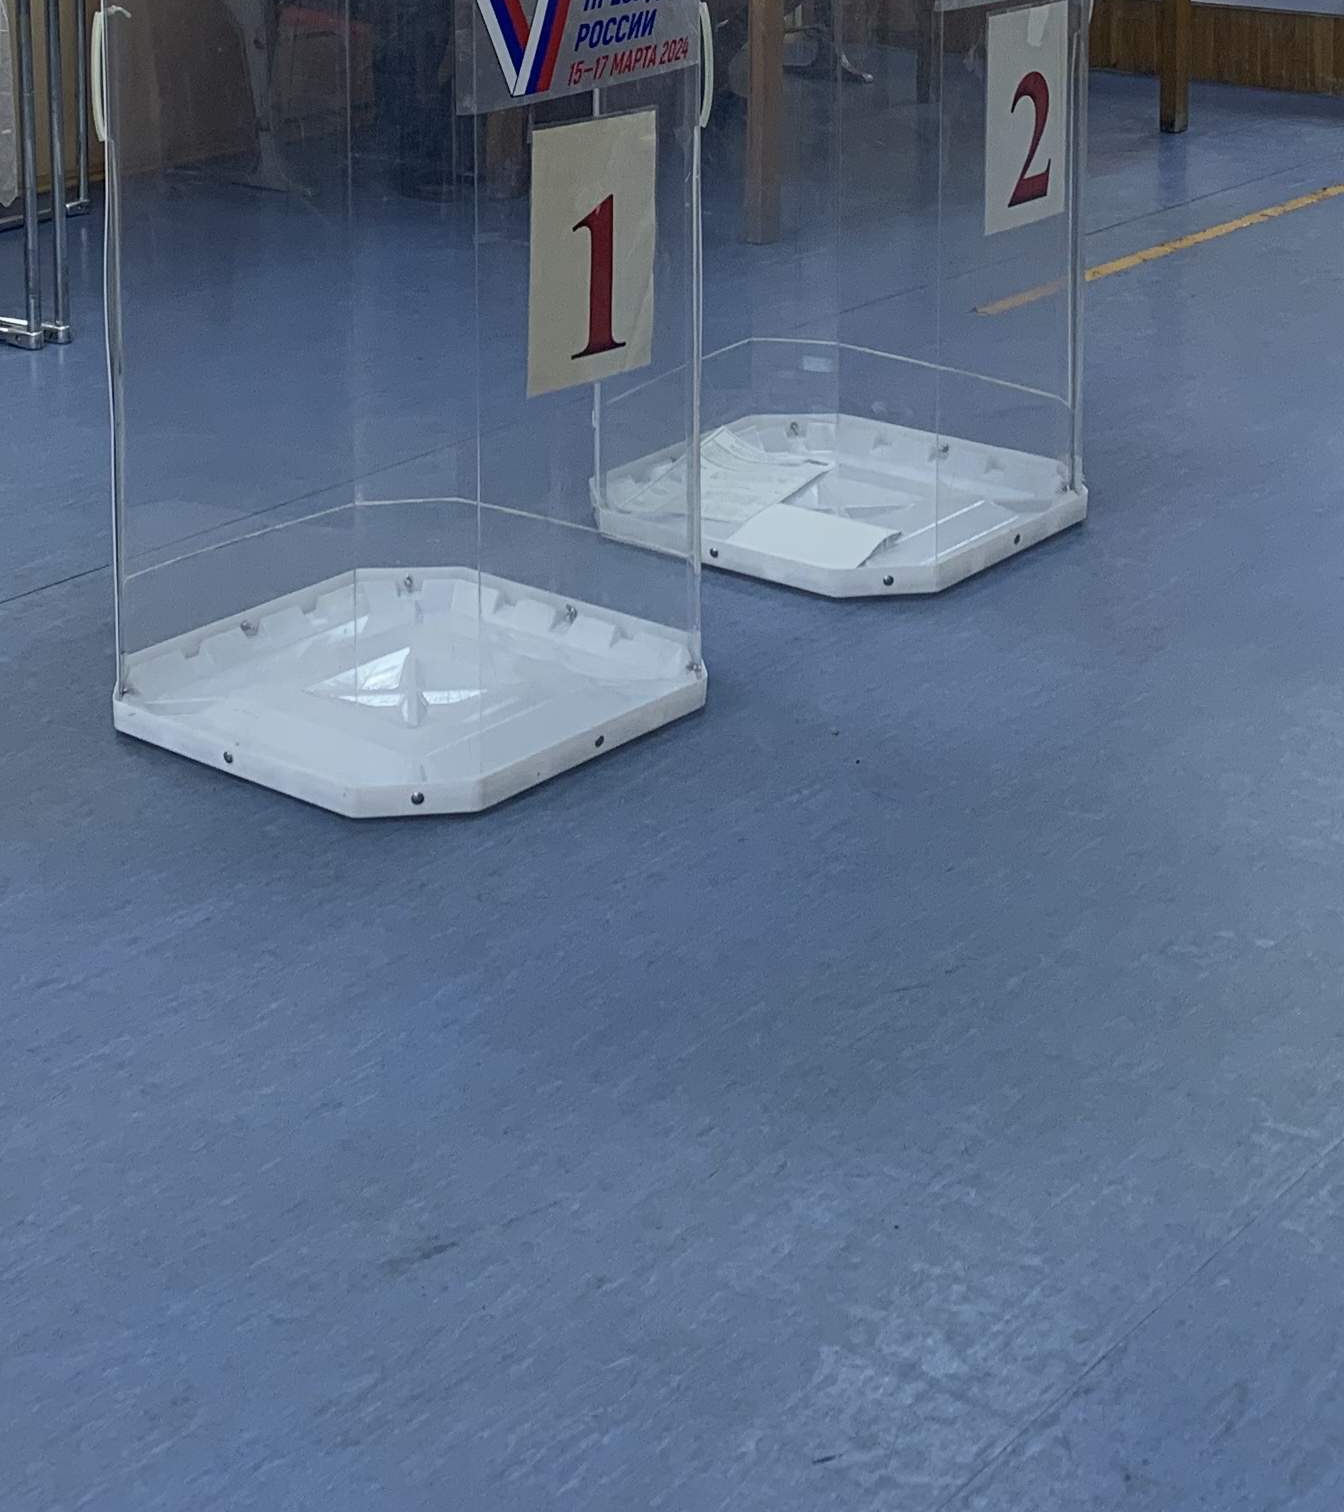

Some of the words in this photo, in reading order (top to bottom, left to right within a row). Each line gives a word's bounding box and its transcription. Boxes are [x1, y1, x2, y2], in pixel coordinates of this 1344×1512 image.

[574, 8, 657, 52] РОССИИ
[609, 44, 656, 77] МАРТА
[658, 36, 690, 66] 2024
[1007, 70, 1051, 209] 2
[570, 193, 626, 360] 1
